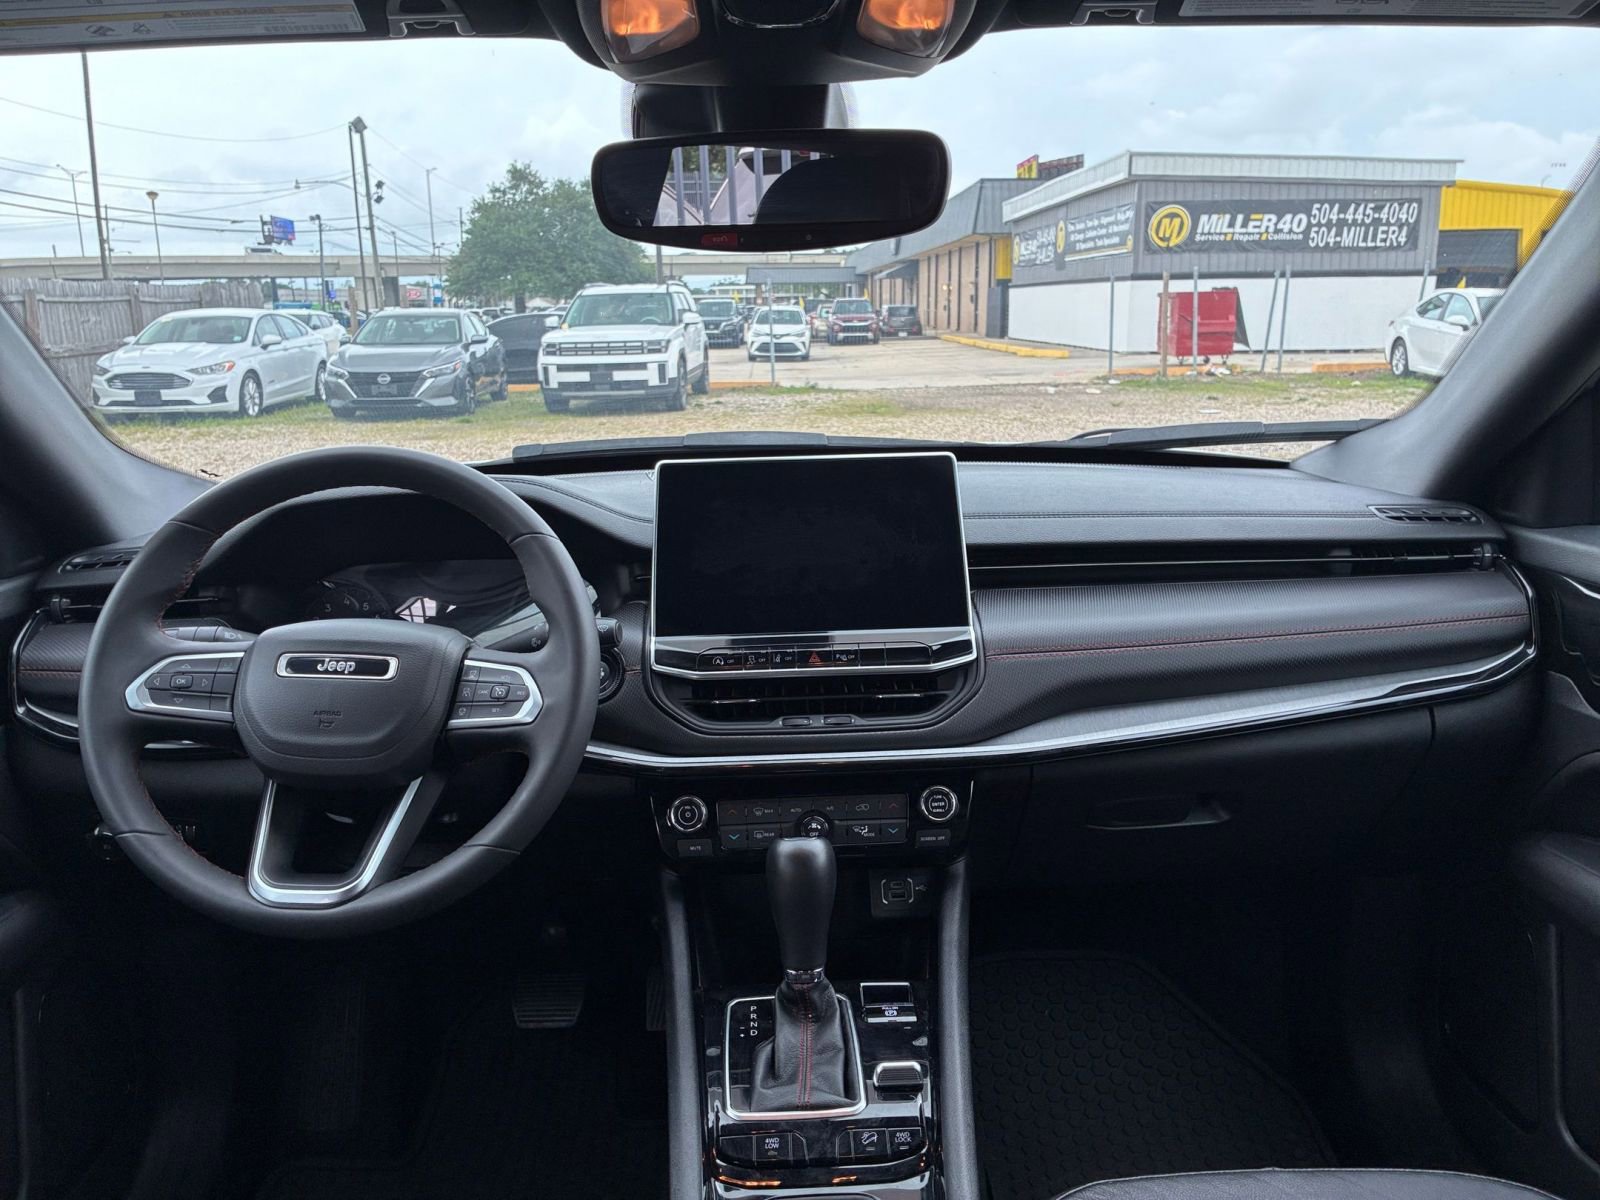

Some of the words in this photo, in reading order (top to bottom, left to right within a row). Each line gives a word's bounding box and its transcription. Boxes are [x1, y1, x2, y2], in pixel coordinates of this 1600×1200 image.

[1310, 202, 1418, 224] 504-445-4040
[1195, 232, 1226, 242] Service
[1232, 231, 1261, 242] Repair
[1268, 230, 1304, 241] Collision
[1309, 225, 1408, 248] 504-MILLER4
[324, 603, 332, 613] 3
[362, 602, 370, 611] 5
[316, 658, 356, 675] Jeep
[750, 1029, 759, 1037] D
